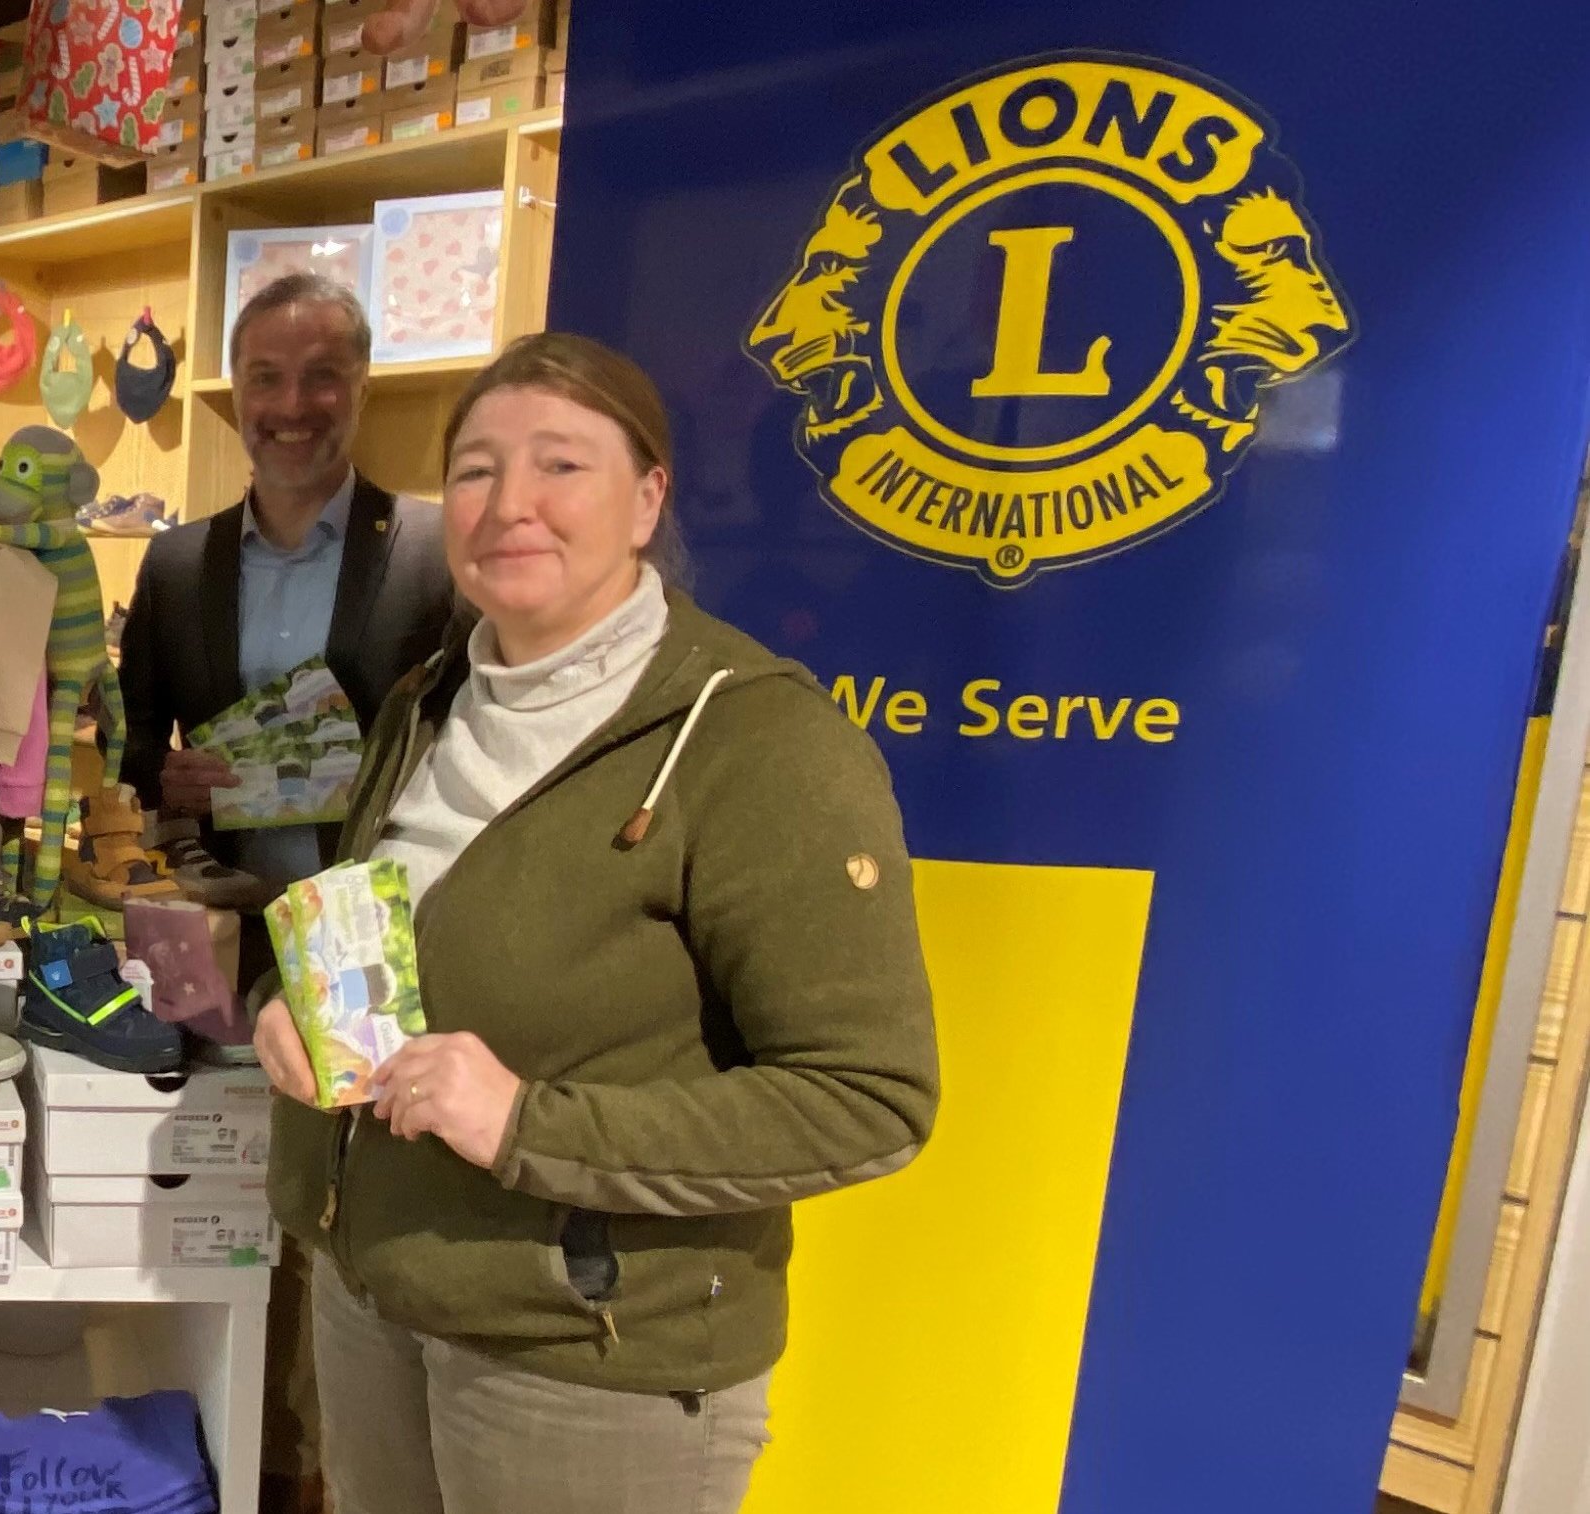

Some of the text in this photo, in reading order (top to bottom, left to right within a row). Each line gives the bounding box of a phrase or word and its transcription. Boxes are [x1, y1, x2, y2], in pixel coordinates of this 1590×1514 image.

[890, 77, 1241, 198] LIONS
[970, 226, 1112, 397] L
[855, 448, 1185, 539] INTERNATIONAL
[960, 678, 1181, 744] Serve
